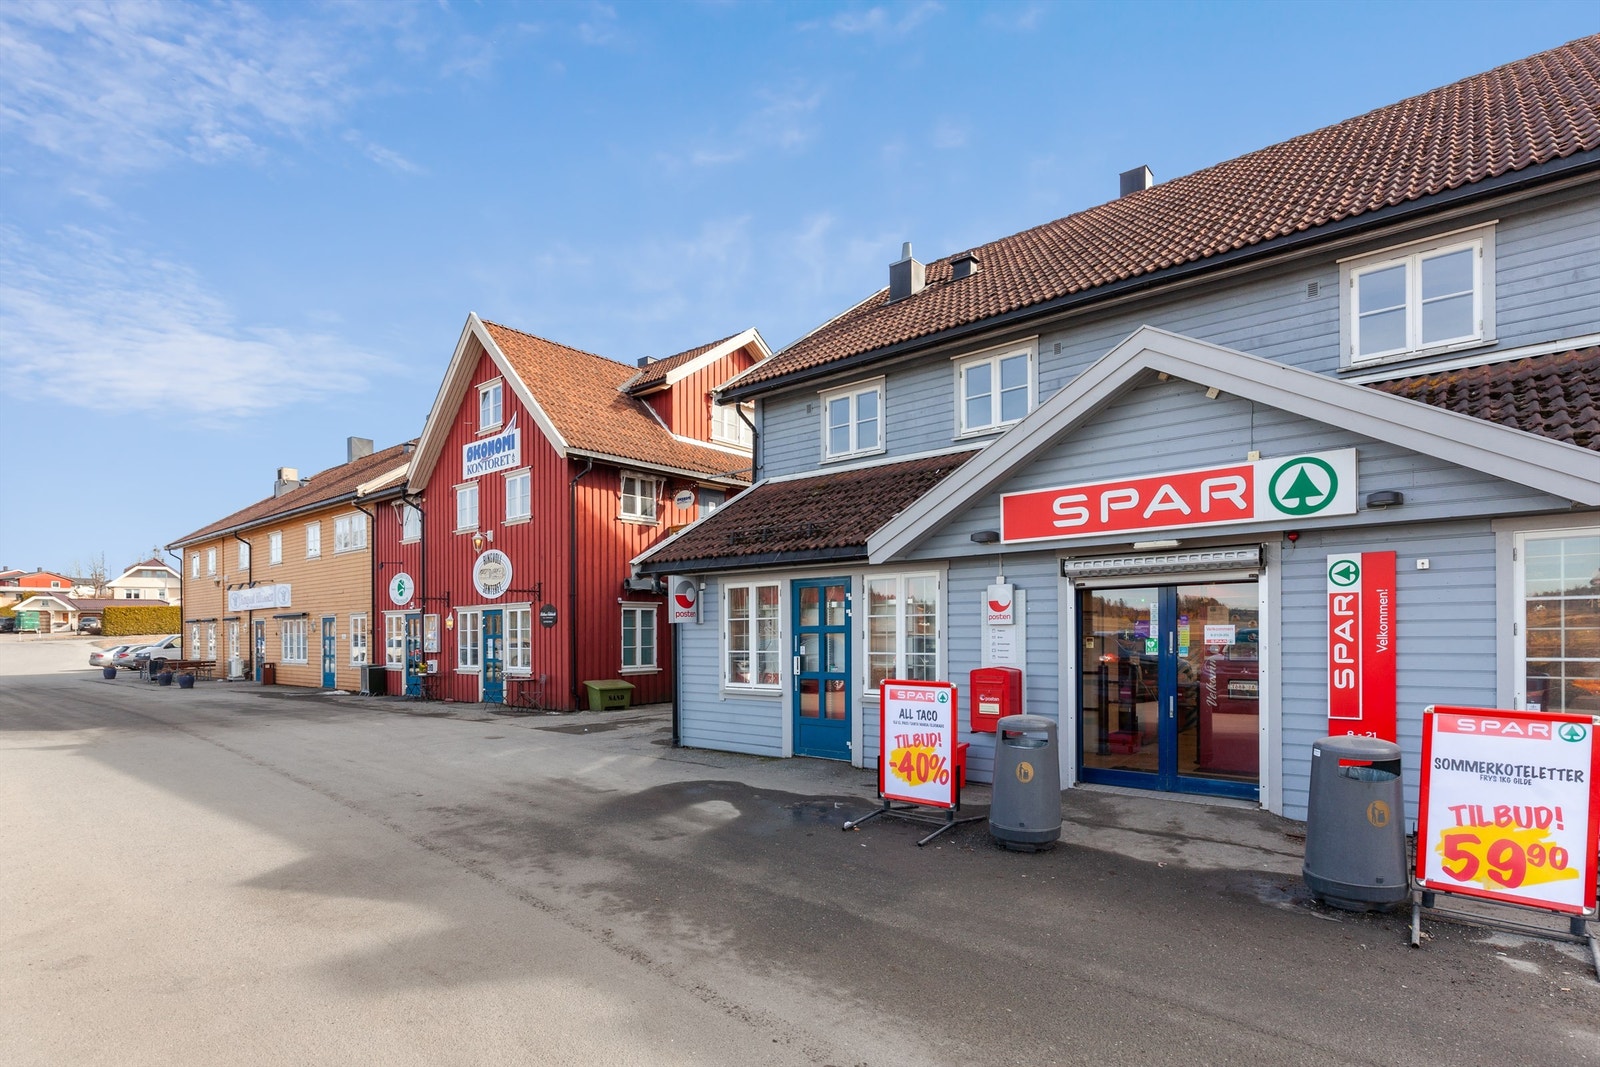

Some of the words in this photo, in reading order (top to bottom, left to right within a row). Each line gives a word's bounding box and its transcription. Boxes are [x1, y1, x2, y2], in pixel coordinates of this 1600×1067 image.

[467, 433, 515, 462] ØKONOMI
[467, 454, 511, 475] KONTORET
[1052, 475, 1248, 527] SPAR
[1376, 588, 1389, 654] Velkommen!
[1333, 594, 1355, 690] SPAR
[897, 691, 935, 701] SPAR
[899, 708, 914, 720] ALL
[916, 709, 938, 722] TACO
[1457, 718, 1551, 738] SPAR
[894, 732, 943, 748] TILBUD!
[889, 751, 950, 785] -40%
[1433, 757, 1585, 783] SOMMERKOTELETTER
[1479, 775, 1498, 783] FRYS
[1499, 776, 1512, 784] 1KG
[1513, 778, 1533, 787] GILDE
[1447, 803, 1565, 831] TILBUD!
